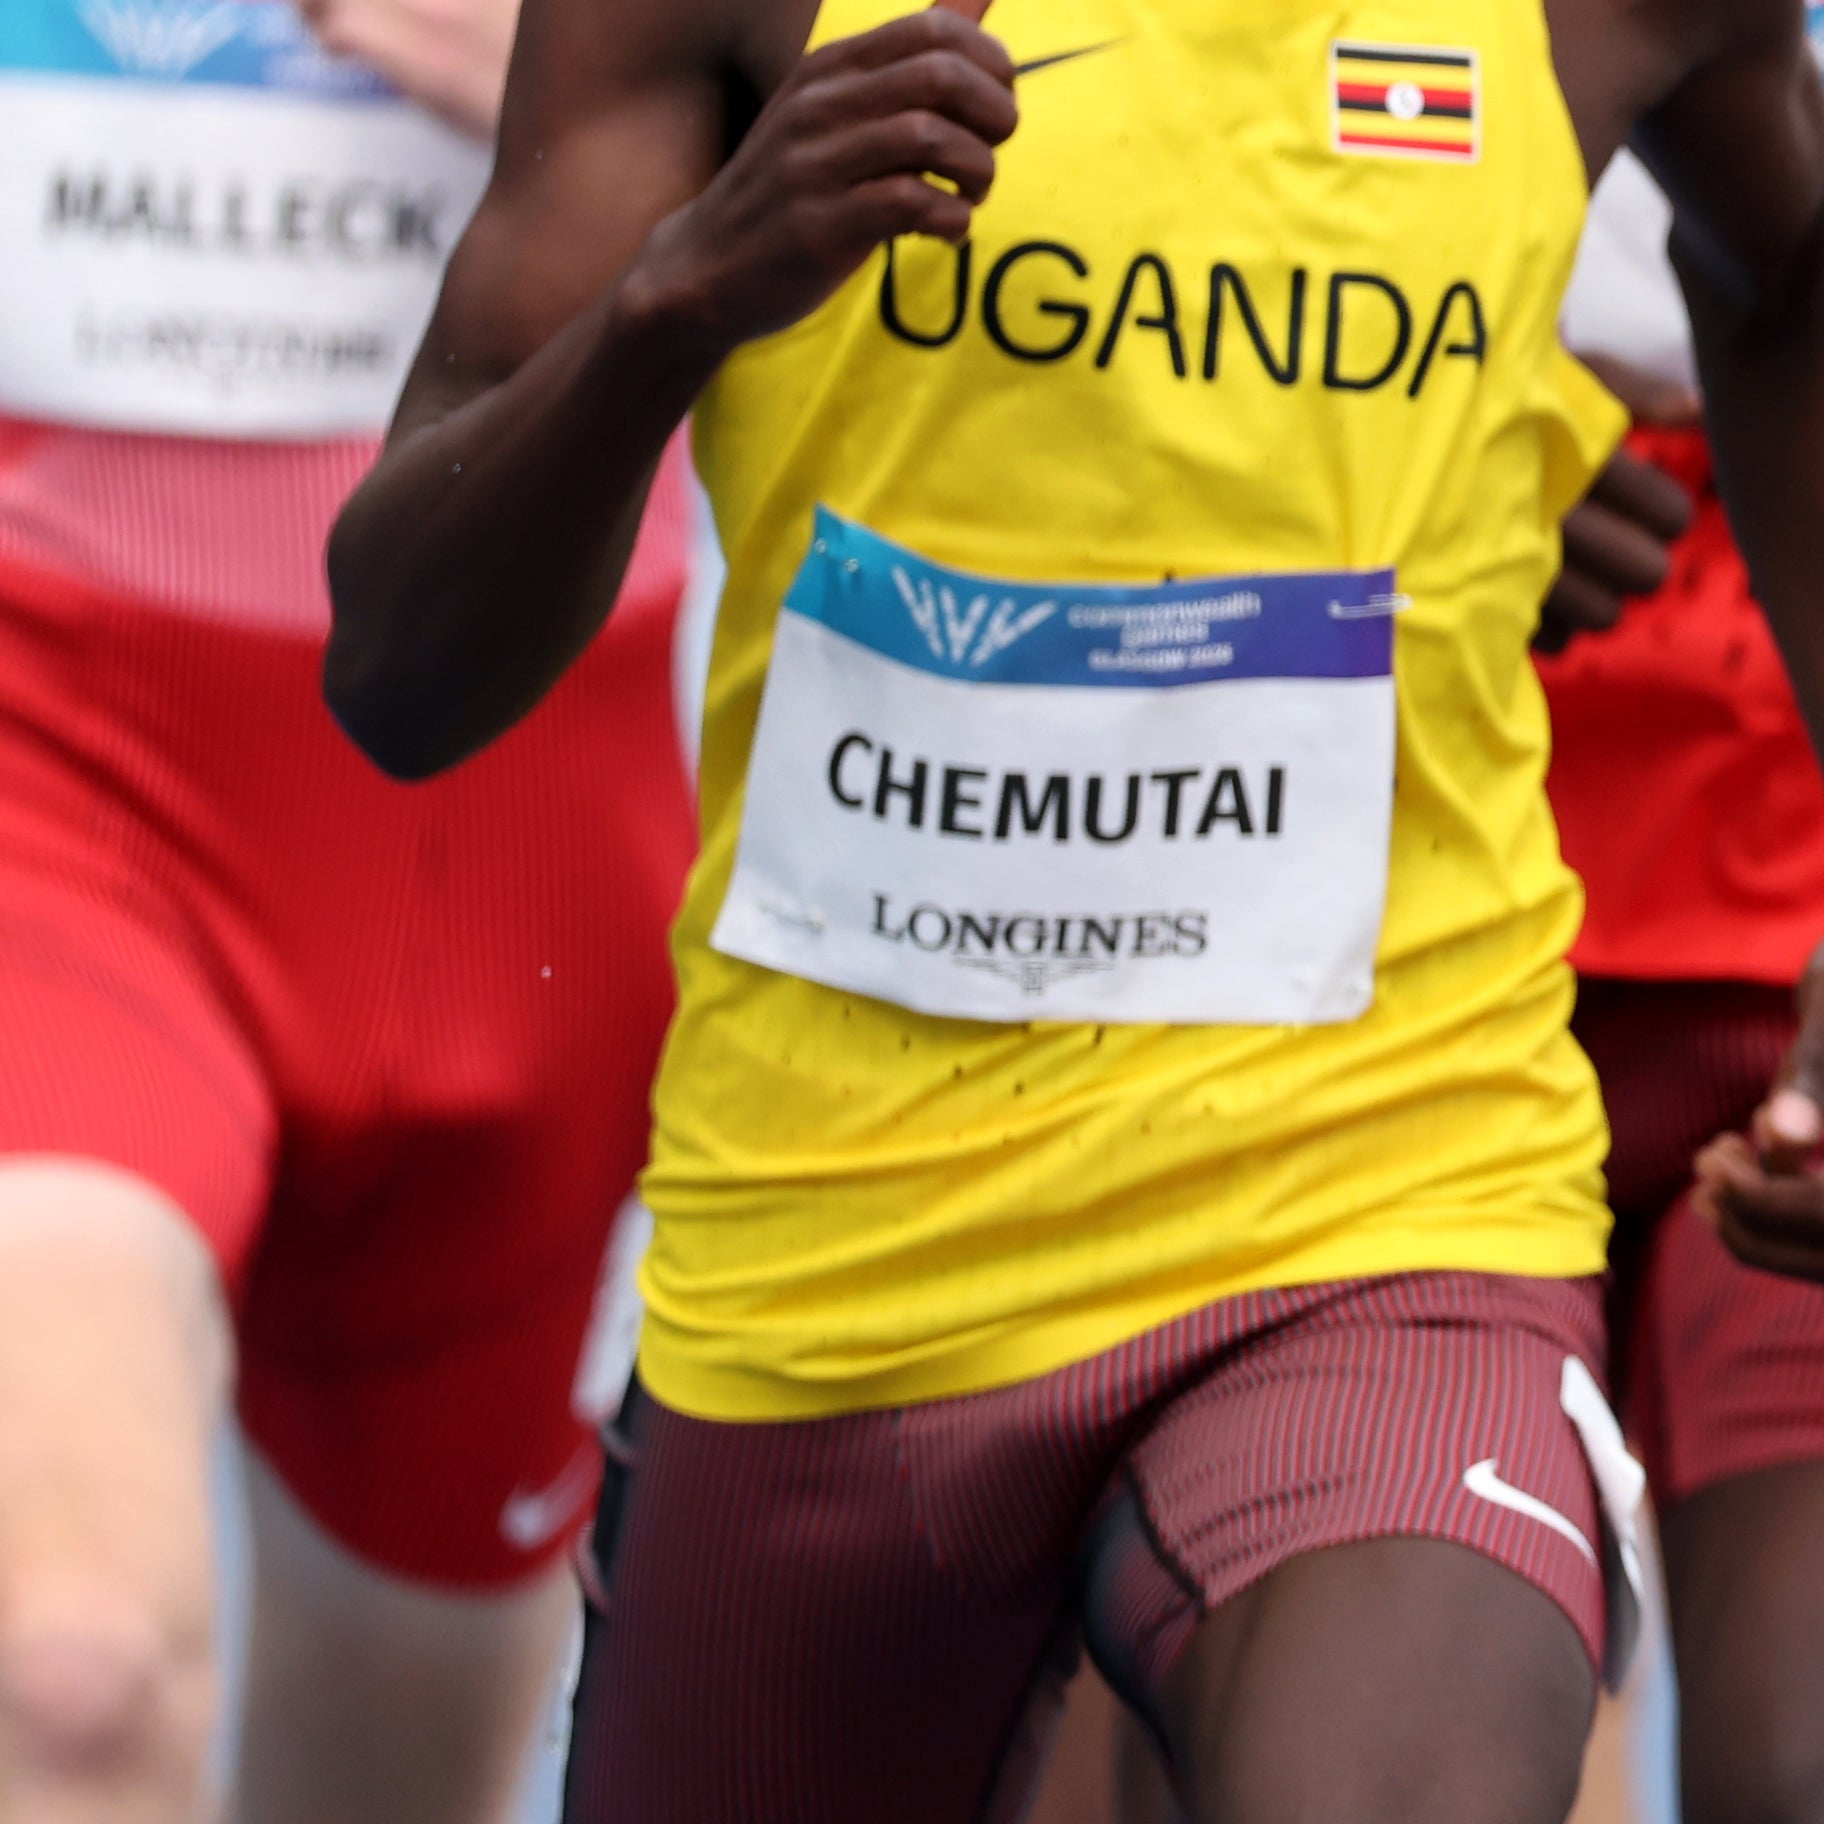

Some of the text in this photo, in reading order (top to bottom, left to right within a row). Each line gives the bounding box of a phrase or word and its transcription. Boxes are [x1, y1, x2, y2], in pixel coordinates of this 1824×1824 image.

[877, 236, 1487, 399] UGANDA
[827, 729, 1287, 844] CHEMUTAI
[871, 890, 1209, 957] LONGINES
